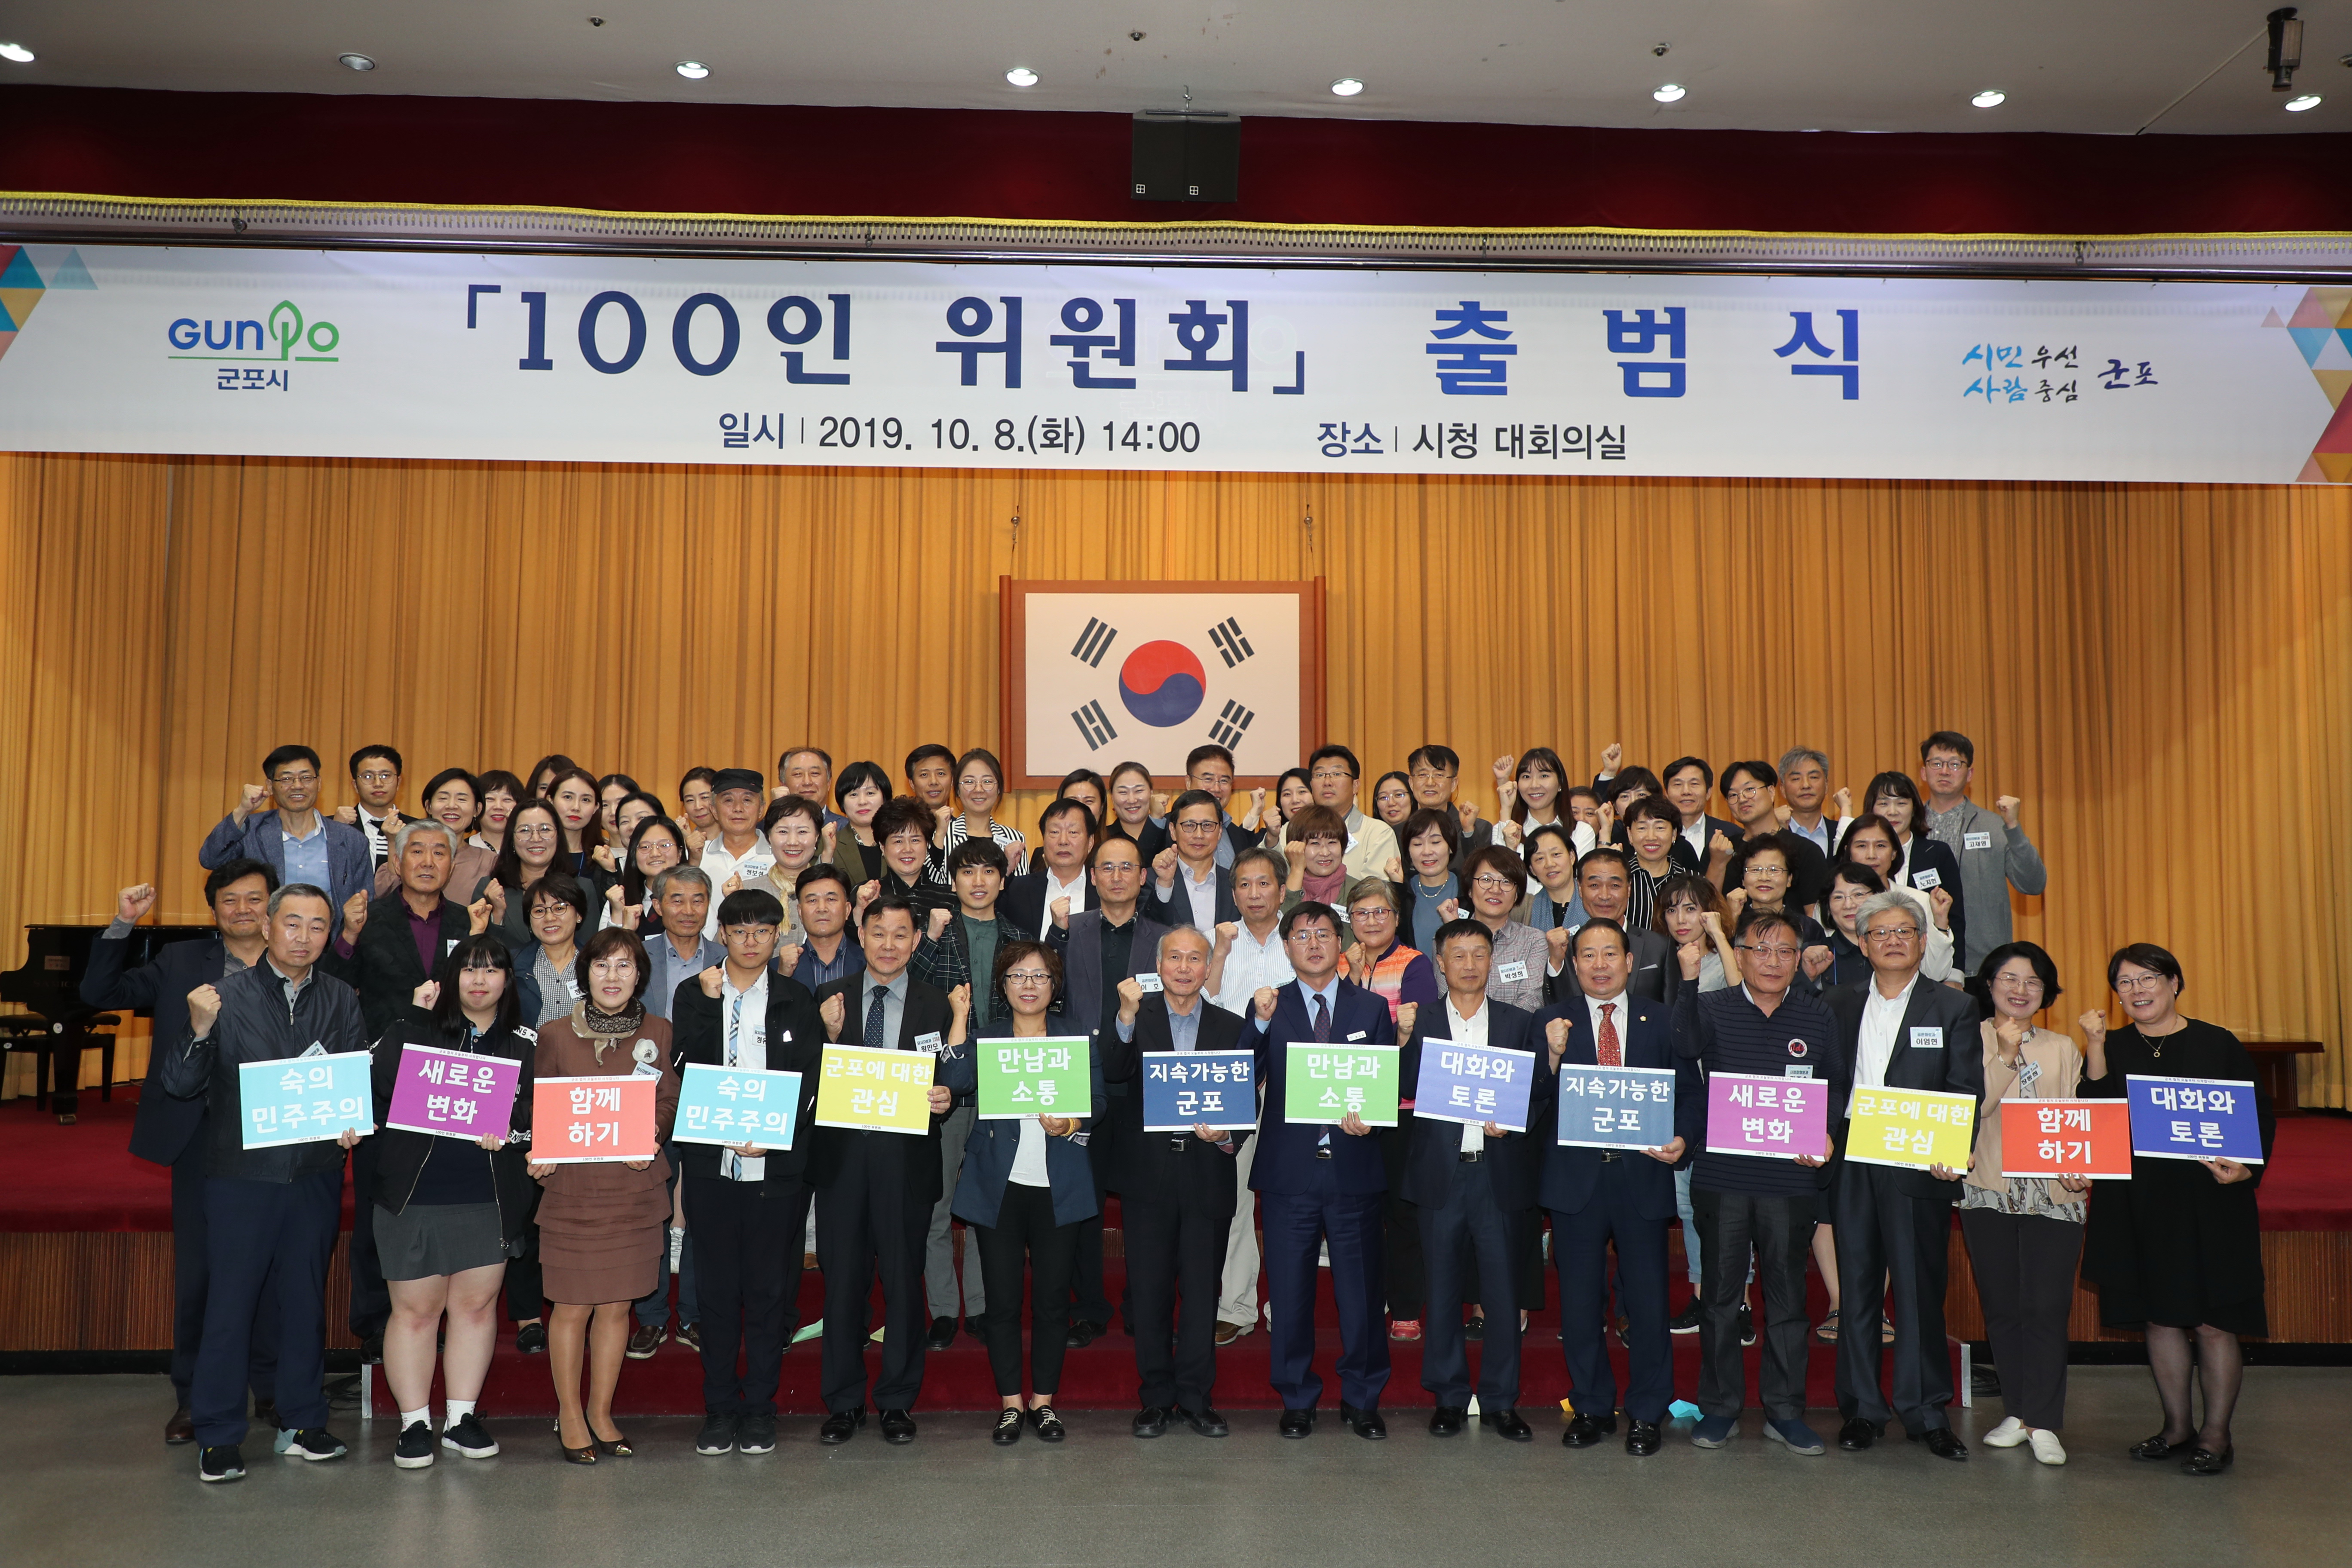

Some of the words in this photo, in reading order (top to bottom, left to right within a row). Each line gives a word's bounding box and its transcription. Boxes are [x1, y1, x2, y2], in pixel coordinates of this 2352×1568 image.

[1963, 344, 2023, 371] 시민
[2032, 346, 2078, 369] 우선
[218, 369, 288, 391] 군포시
[2098, 359, 2158, 389] 군포
[1964, 375, 2027, 403] 사람
[2035, 380, 2078, 403] 중심
[720, 413, 784, 449] 일시
[820, 416, 911, 450] 2019.
[932, 419, 978, 451] 10.
[995, 415, 1084, 455] 8.(화)
[1103, 421, 1200, 452] 14:00
[1317, 422, 1383, 457] 장소
[1413, 423, 1477, 459] 시청
[1496, 424, 1625, 459] 대회의실
[826, 1057, 885, 1080] 군포에
[891, 1063, 932, 1085] 대한
[998, 1047, 1071, 1073] 만남과
[1150, 1061, 1250, 1083] 지속가능한
[1308, 1054, 1381, 1079] 만남과
[1441, 1051, 1515, 1082] 대화와
[280, 1066, 333, 1094] 숙의
[418, 1060, 496, 1093] 새로운
[717, 1076, 766, 1101] 숙의
[1566, 1077, 1670, 1102] 지속가능한
[570, 1087, 620, 1114] 함께
[851, 1088, 898, 1116] 관심
[1012, 1080, 1058, 1106] 소통
[1177, 1092, 1223, 1115] 군포
[1319, 1087, 1366, 1112] 소통
[1449, 1085, 1496, 1113] 토론
[1729, 1085, 1806, 1113] 새로운
[2151, 1087, 2235, 1114] 대화와
[252, 1096, 363, 1133] 민주주의
[427, 1094, 478, 1124] 변화
[686, 1106, 787, 1135] 민주주의
[1592, 1107, 1640, 1132] 군포
[1857, 1096, 1920, 1120] 군포에
[1927, 1104, 1971, 1126] 대한
[2037, 1107, 2090, 1133] 함께
[569, 1122, 618, 1146] 하기
[1743, 1118, 1793, 1143] 변화
[1883, 1127, 1934, 1155] 관심
[2170, 1121, 2223, 1147] 토론
[2038, 1139, 2091, 1164] 하기
